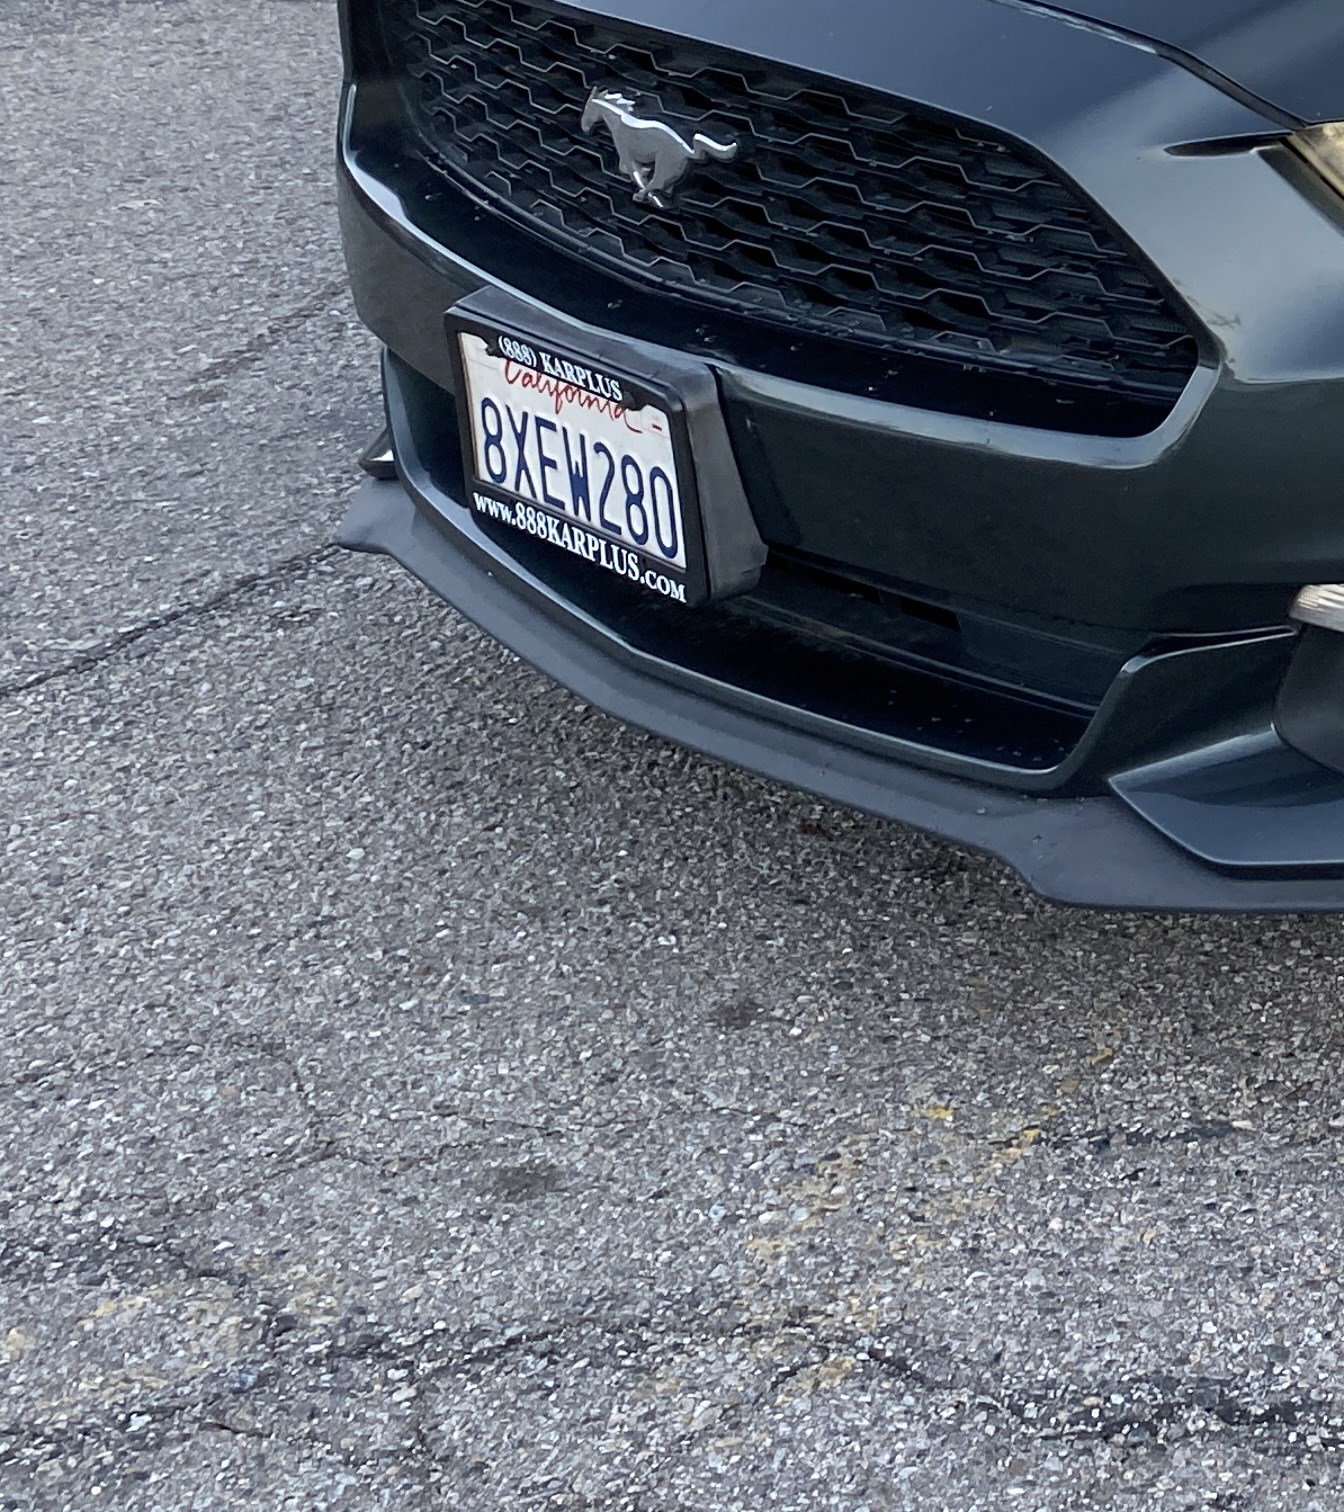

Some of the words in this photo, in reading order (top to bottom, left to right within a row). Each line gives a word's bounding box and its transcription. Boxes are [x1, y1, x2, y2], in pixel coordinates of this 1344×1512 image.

[499, 336, 537, 368] (888)
[540, 351, 623, 402] KARPLUS
[481, 396, 679, 560] 8XEW280
